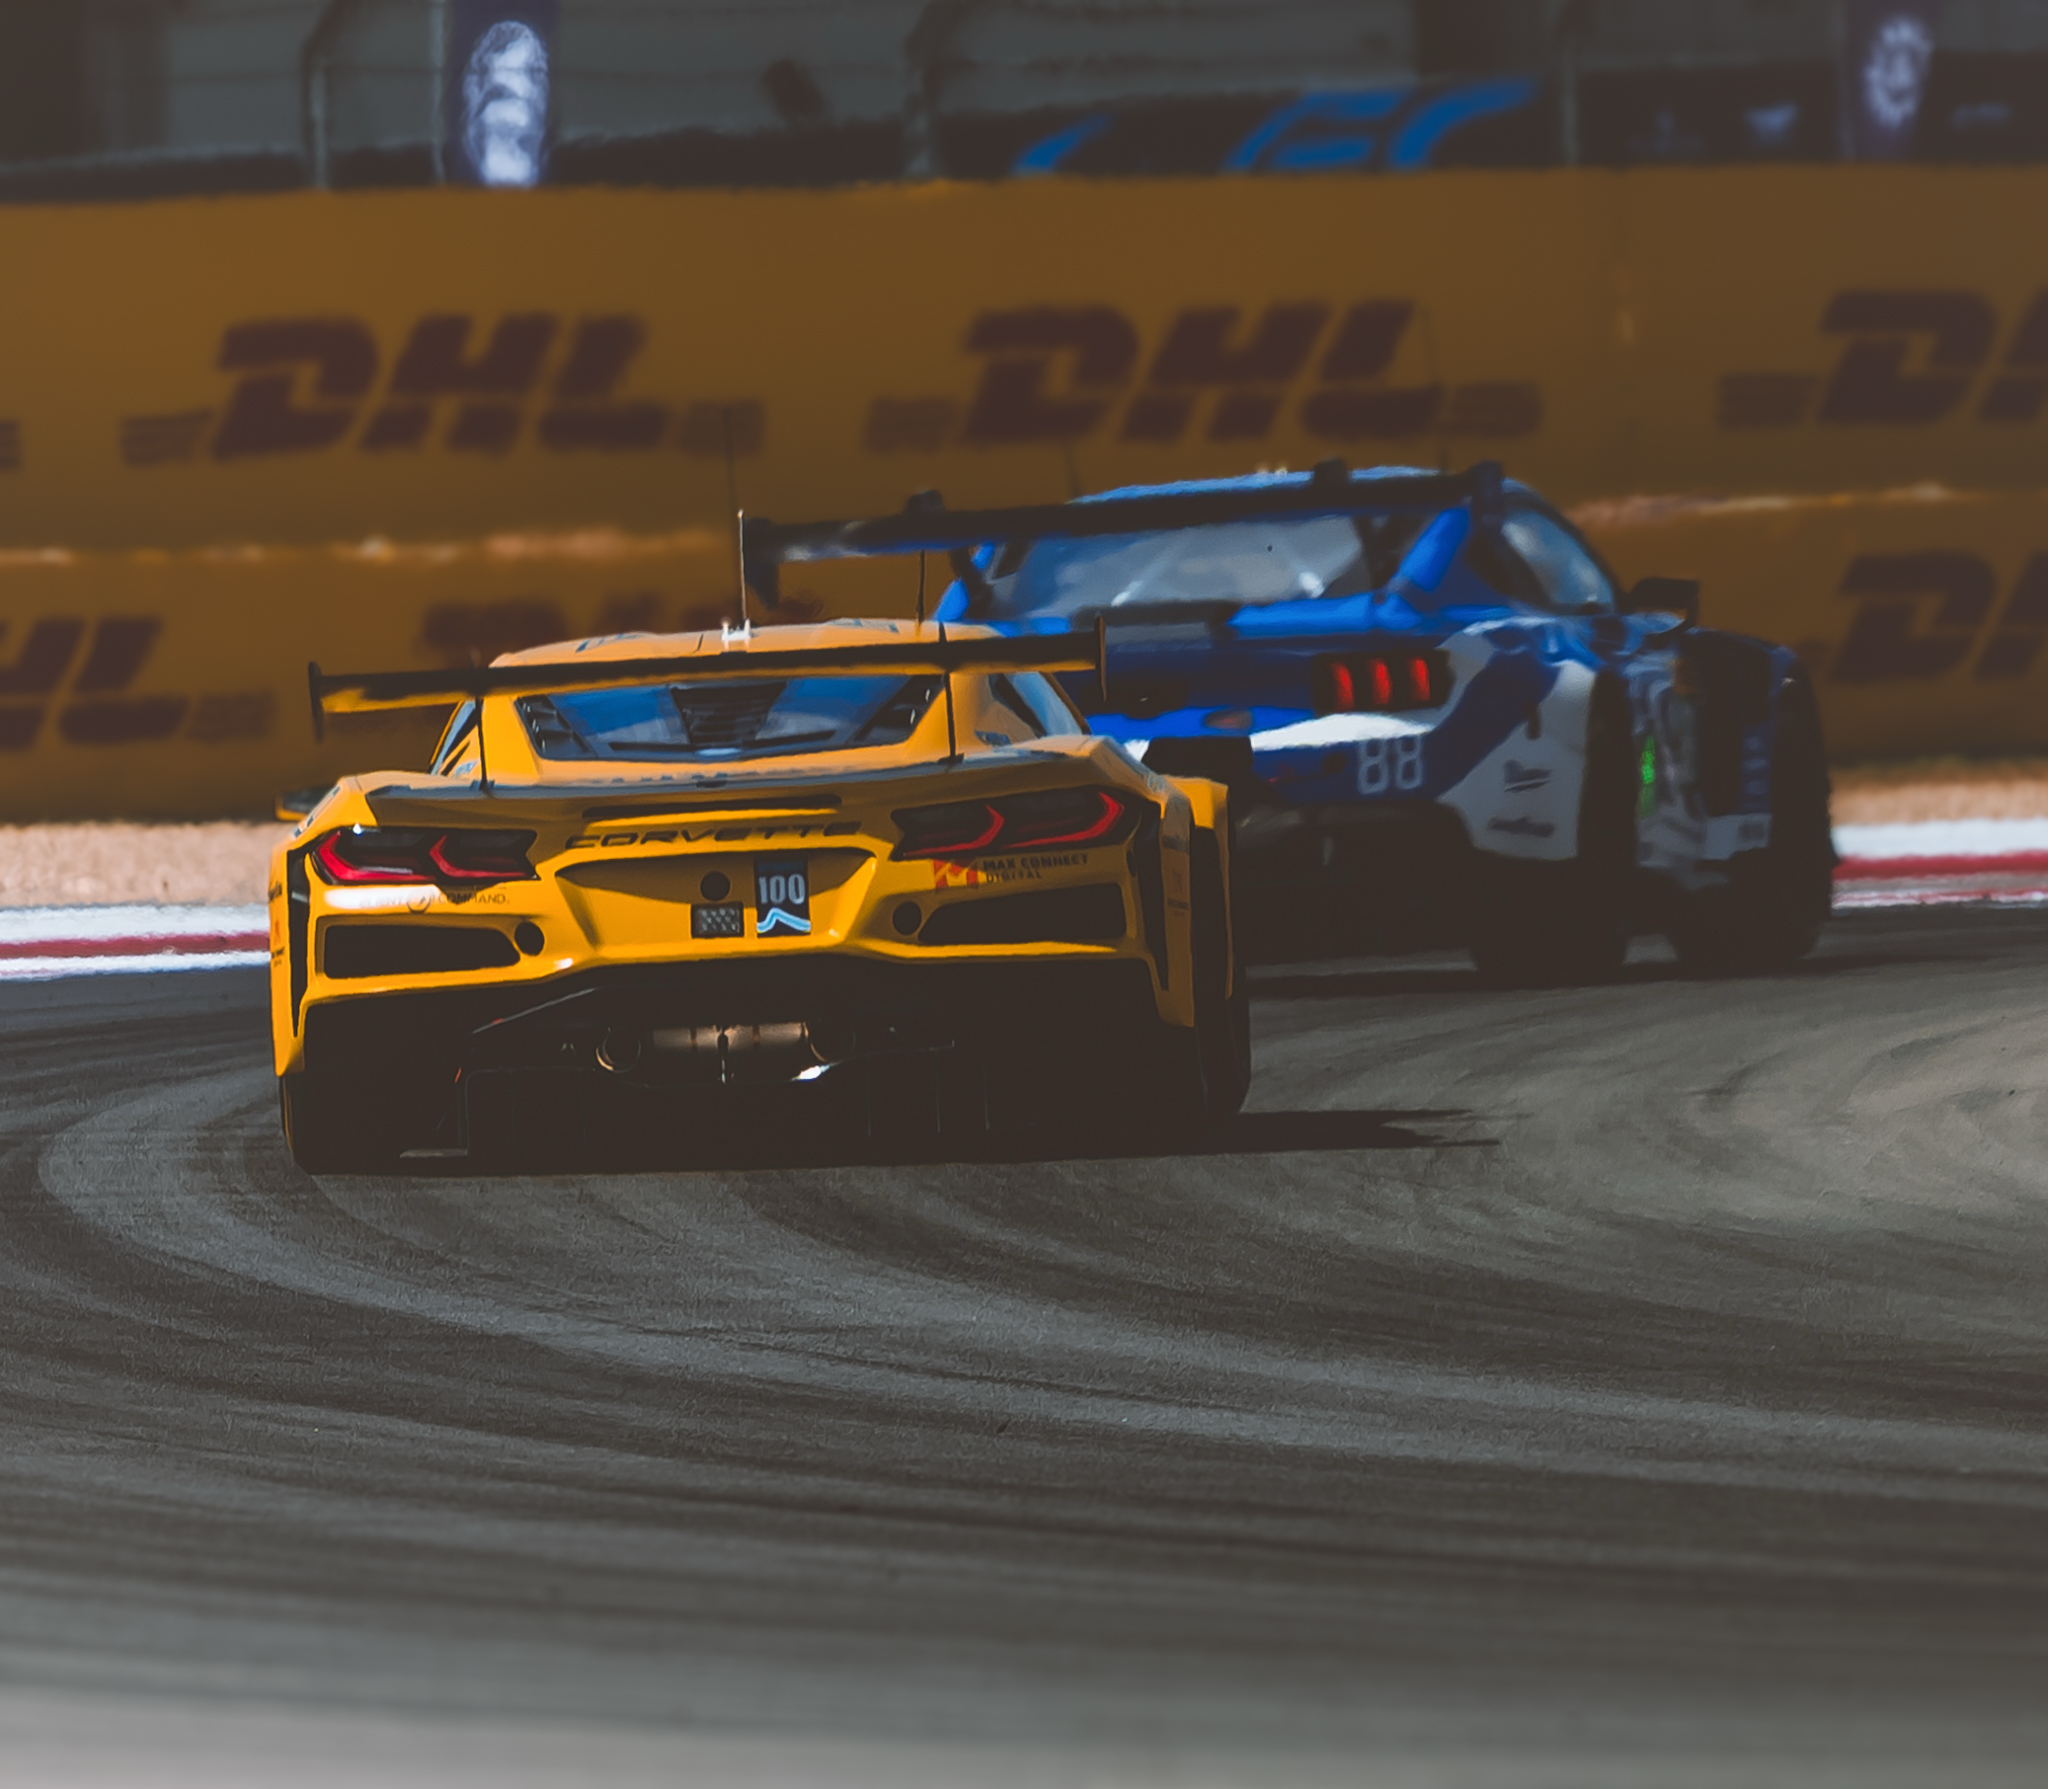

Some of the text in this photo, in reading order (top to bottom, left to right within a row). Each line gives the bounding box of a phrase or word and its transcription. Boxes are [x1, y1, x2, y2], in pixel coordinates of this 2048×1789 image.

[209, 311, 672, 464] DHL
[952, 297, 1446, 446] DHL
[1357, 735, 1425, 796] 88
[565, 821, 862, 850] CORVETTE
[983, 853, 1088, 872] MAX CONNECT
[986, 868, 1042, 883] DIGITAL
[758, 873, 806, 905] 100
